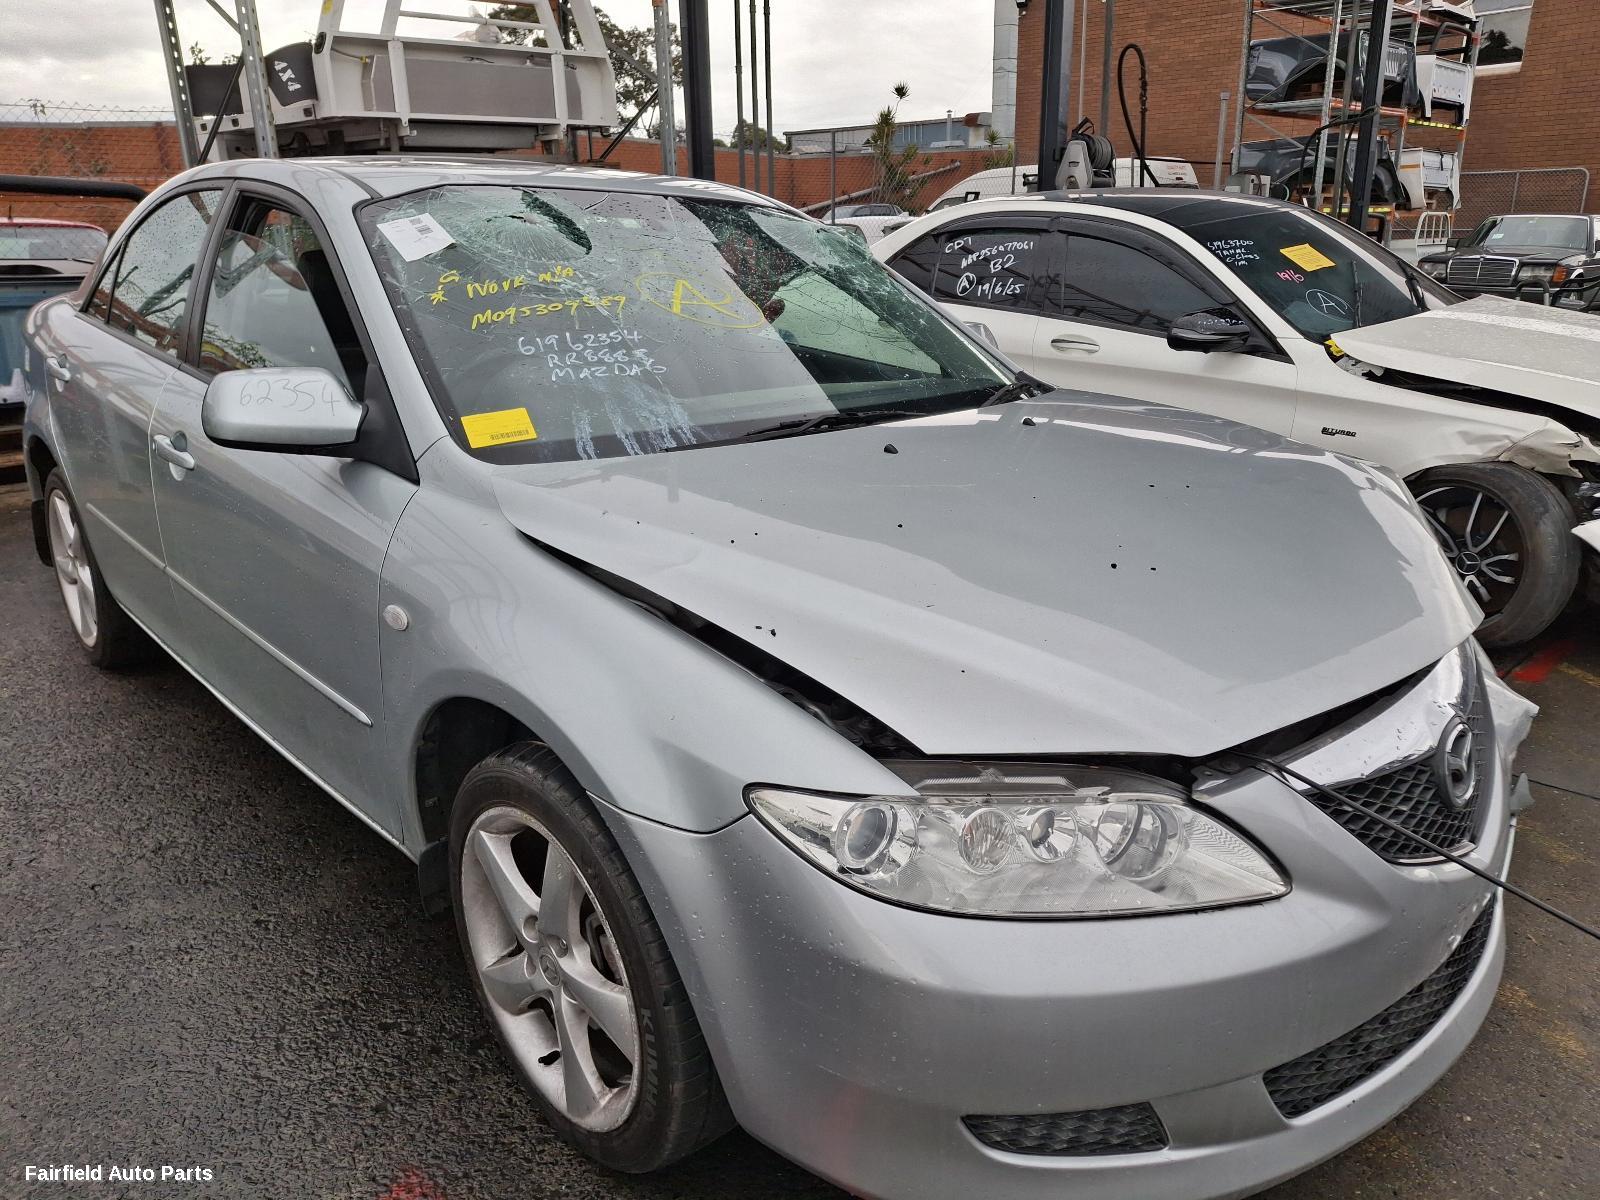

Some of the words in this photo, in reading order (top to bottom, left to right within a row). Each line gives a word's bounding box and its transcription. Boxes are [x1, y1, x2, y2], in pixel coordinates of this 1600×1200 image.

[989, 254, 1017, 274] B2
[977, 277, 1025, 300] 19/6/25
[240, 378, 342, 417] 62354
[1321, 426, 1357, 438] BITURBO
